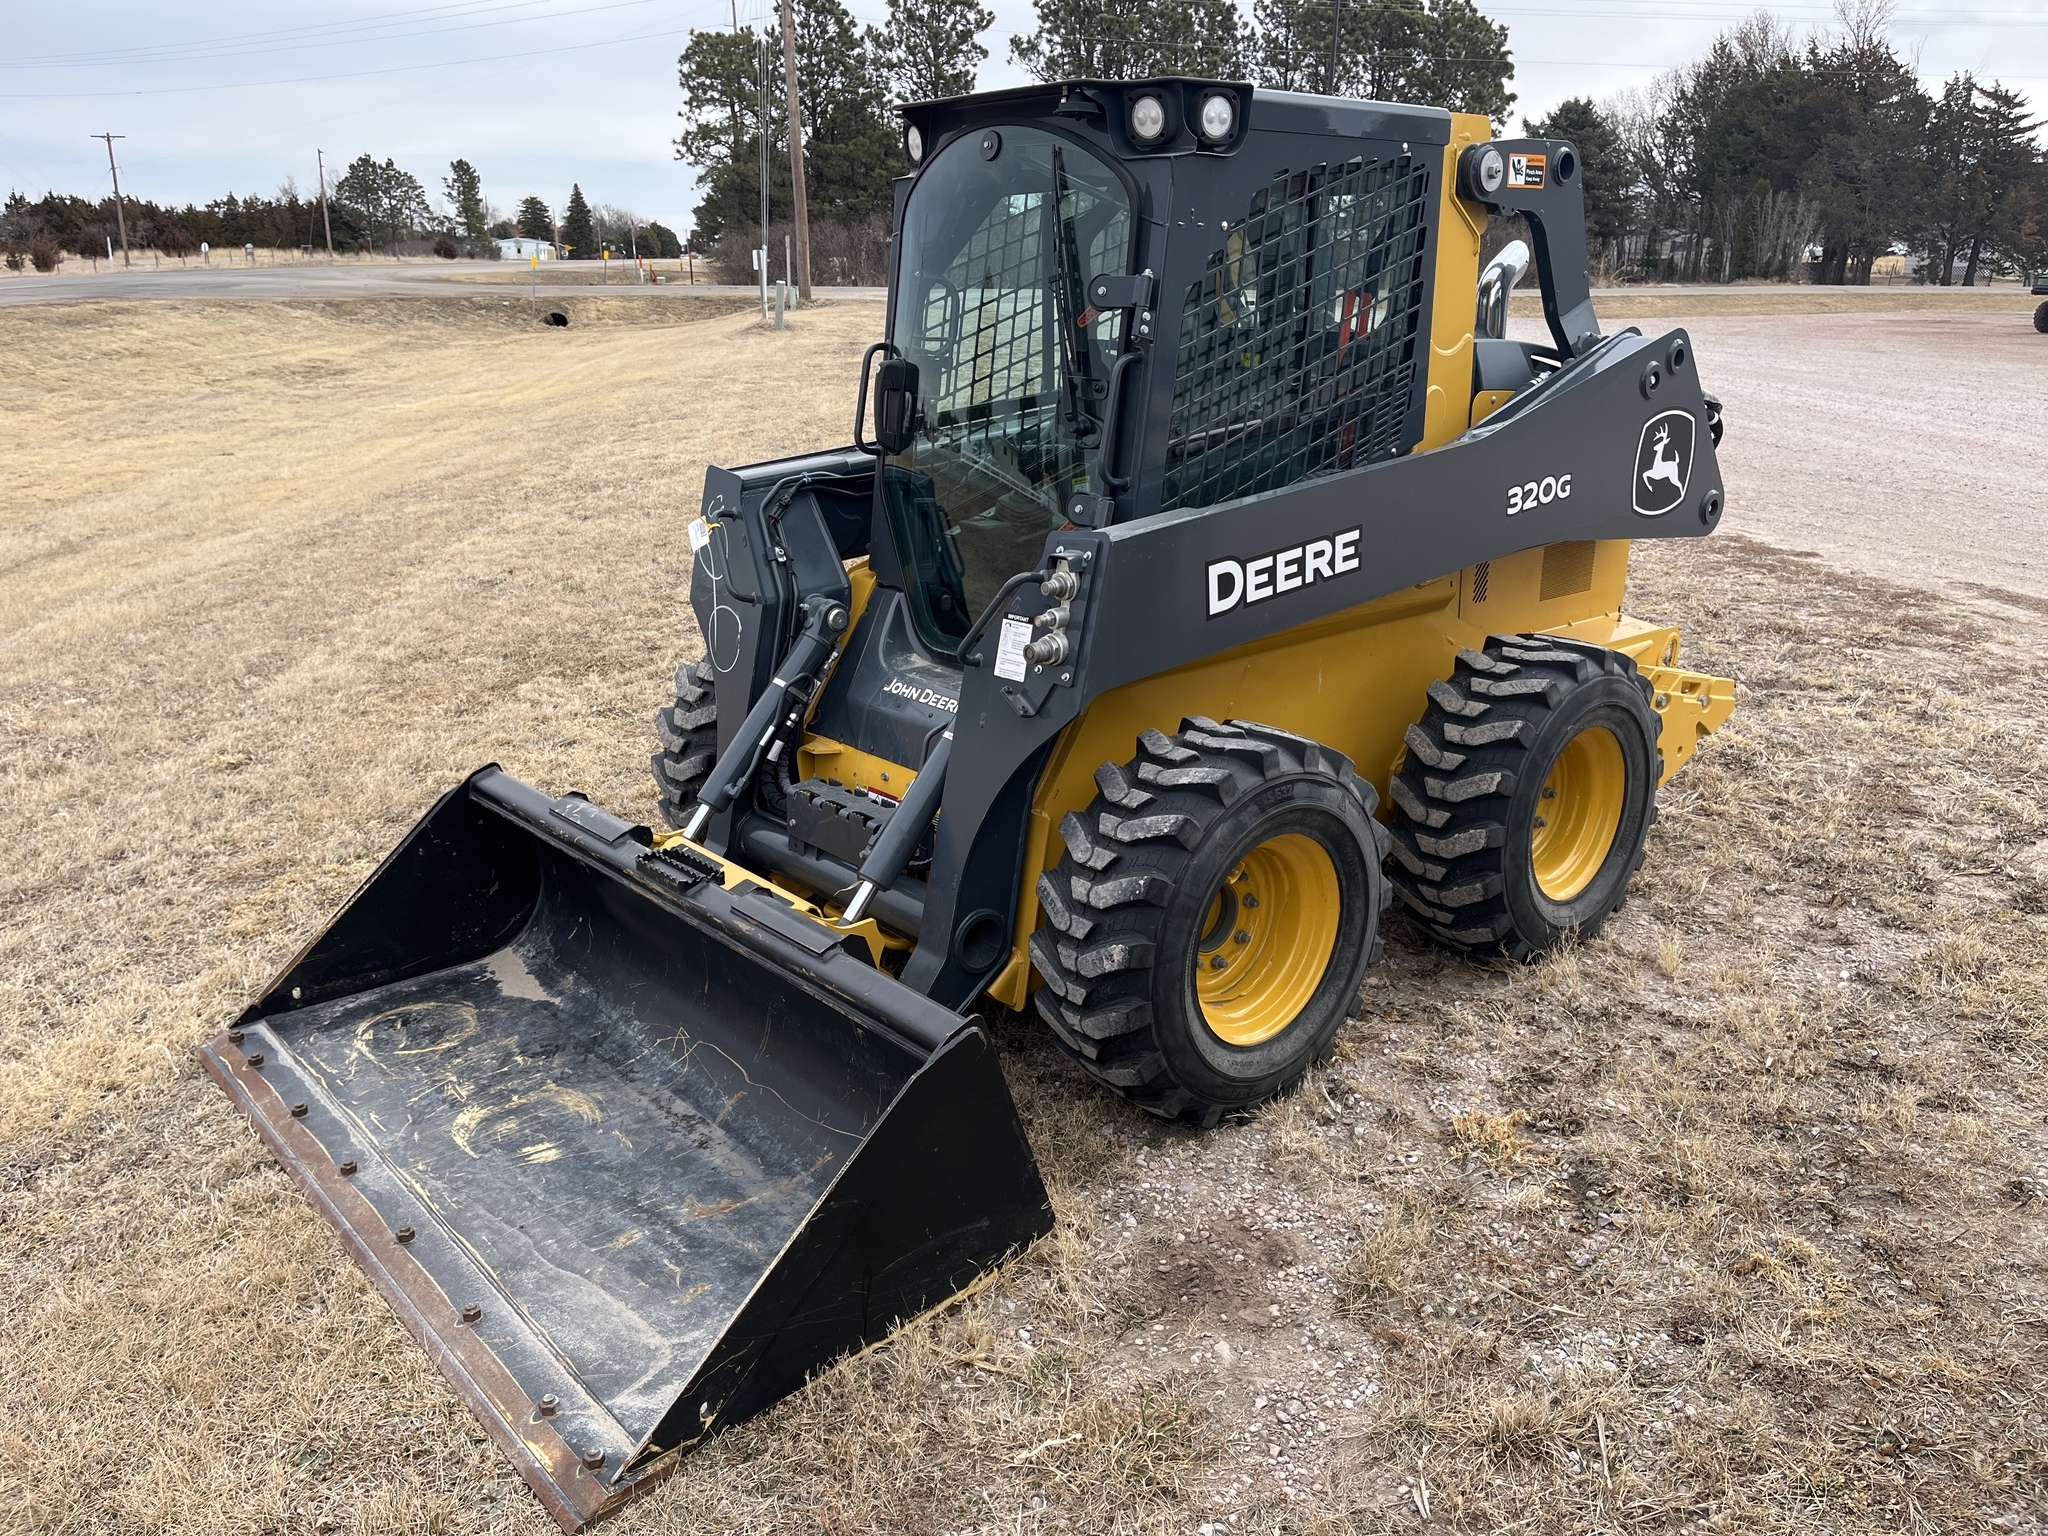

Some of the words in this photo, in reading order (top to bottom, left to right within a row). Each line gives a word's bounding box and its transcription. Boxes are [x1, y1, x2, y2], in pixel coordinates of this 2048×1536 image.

[1507, 474, 1571, 515] 320G
[1208, 529, 1360, 616] DEERE
[1007, 613, 1030, 623] IMPORTANT
[883, 678, 921, 701] JOHN
[919, 688, 959, 714] DEER
